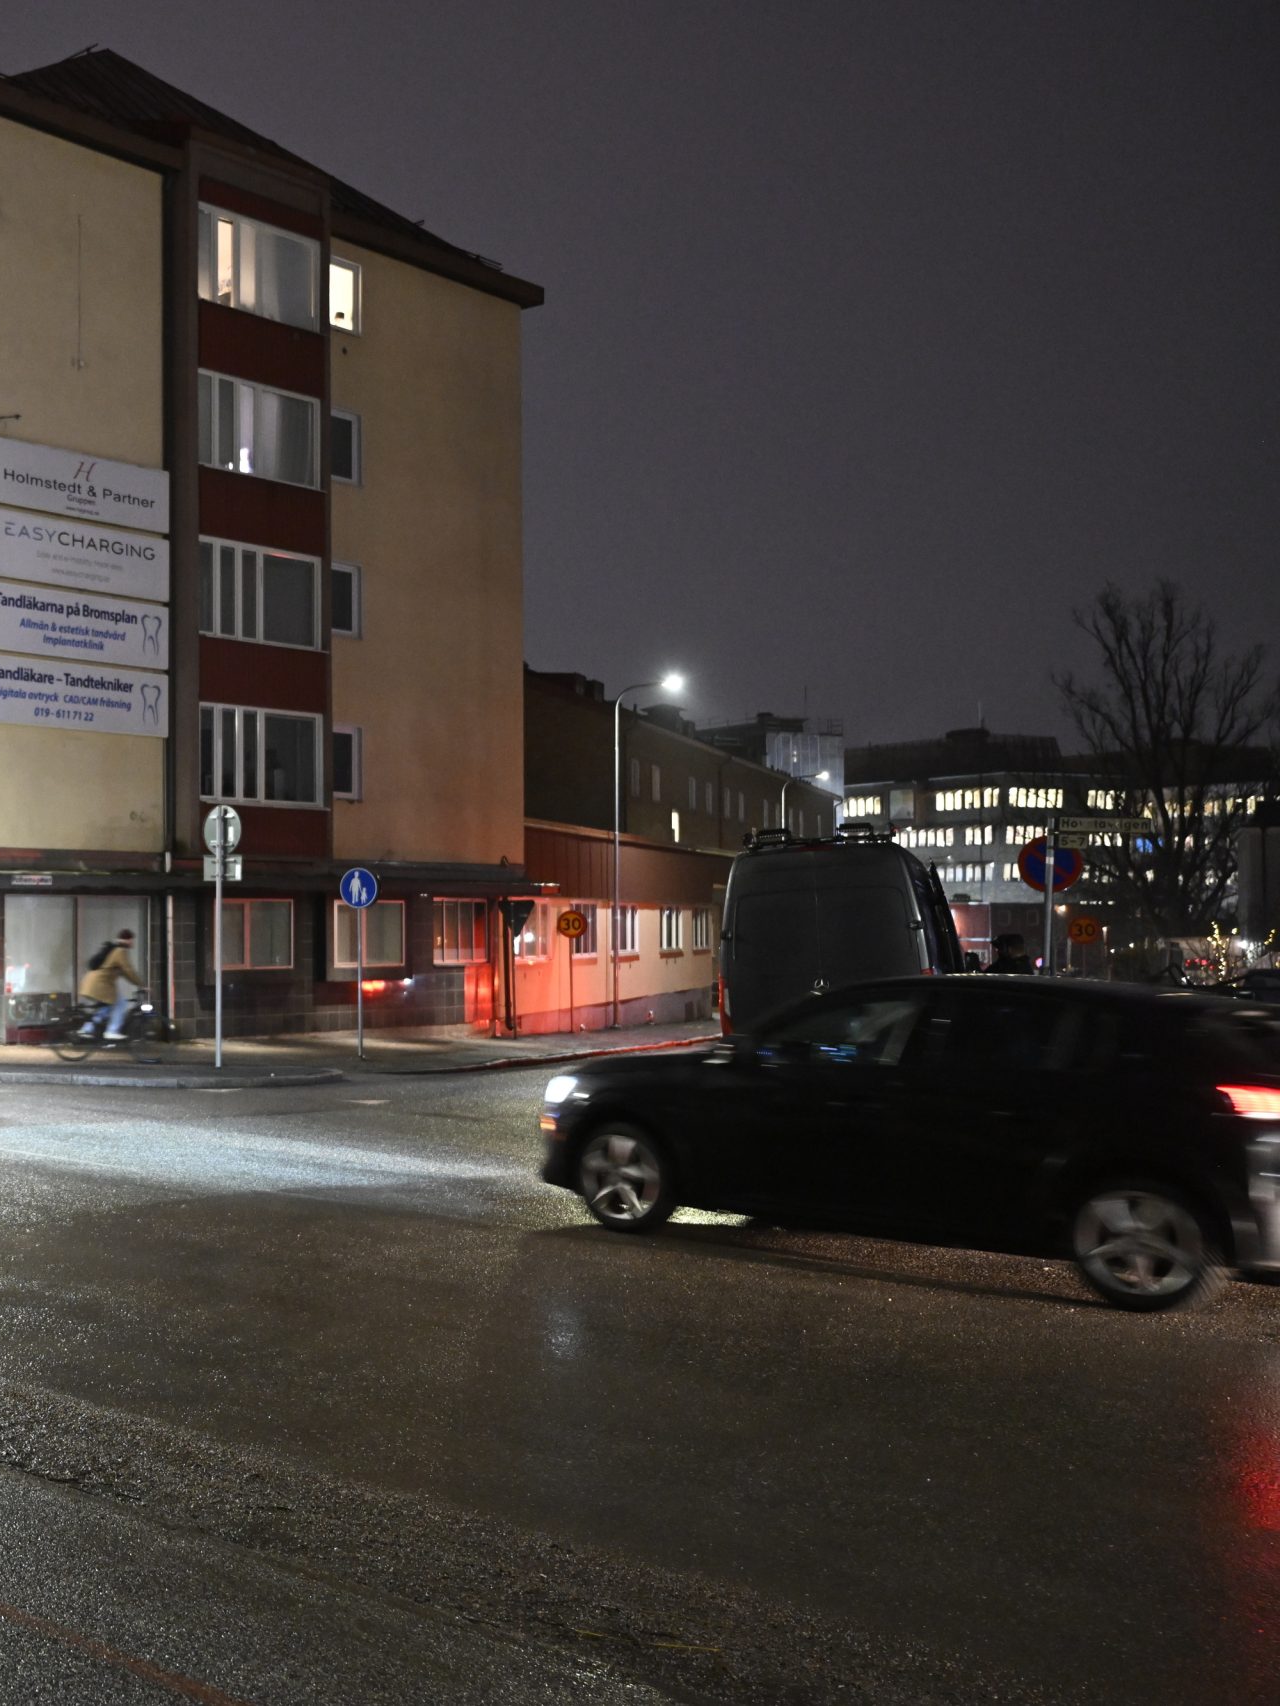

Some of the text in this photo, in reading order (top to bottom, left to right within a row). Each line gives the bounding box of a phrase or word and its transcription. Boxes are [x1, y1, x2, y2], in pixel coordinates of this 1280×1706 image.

[3, 468, 155, 509] Holmstedt & Partner
[4, 521, 156, 561] EASYCHARGING
[66, 603, 80, 619] på
[82, 604, 138, 625] Bromsplan
[19, 618, 126, 641] Allmän & estetisk tandvård
[42, 633, 105, 651] Implantatklinik
[64, 673, 133, 693] Tandtekniker
[28, 691, 59, 703] avtryck
[64, 694, 99, 707] CAD/CAM
[99, 697, 132, 712] fräsning
[83, 711, 95, 722] 22
[1061, 835, 1086, 847] 5-7
[562, 917, 581, 931] 30
[1074, 922, 1096, 937] 30
